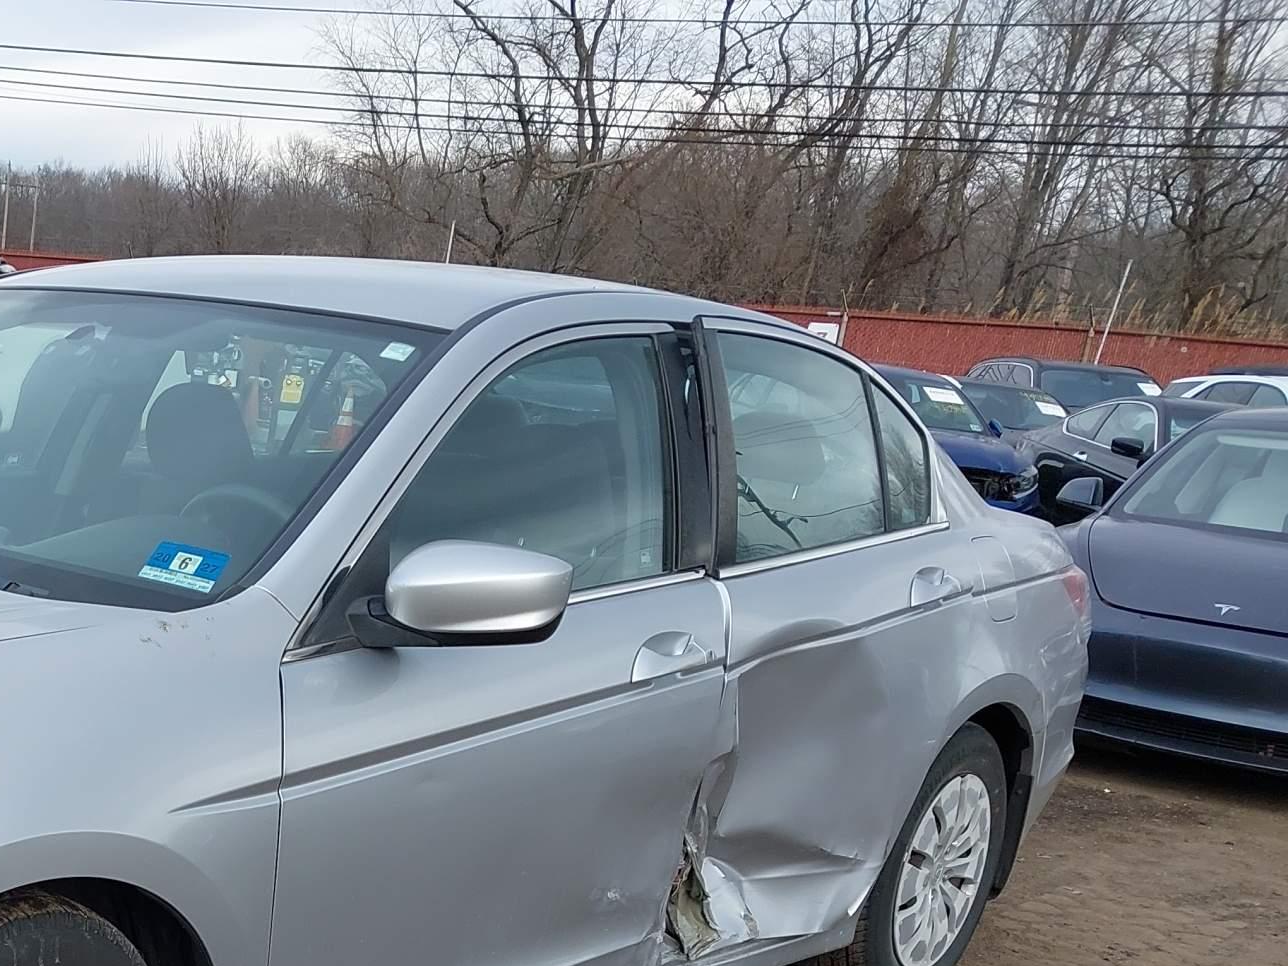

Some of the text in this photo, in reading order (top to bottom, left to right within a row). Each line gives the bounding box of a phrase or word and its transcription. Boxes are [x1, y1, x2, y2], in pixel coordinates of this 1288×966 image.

[154, 552, 217, 574] 20 6 27
